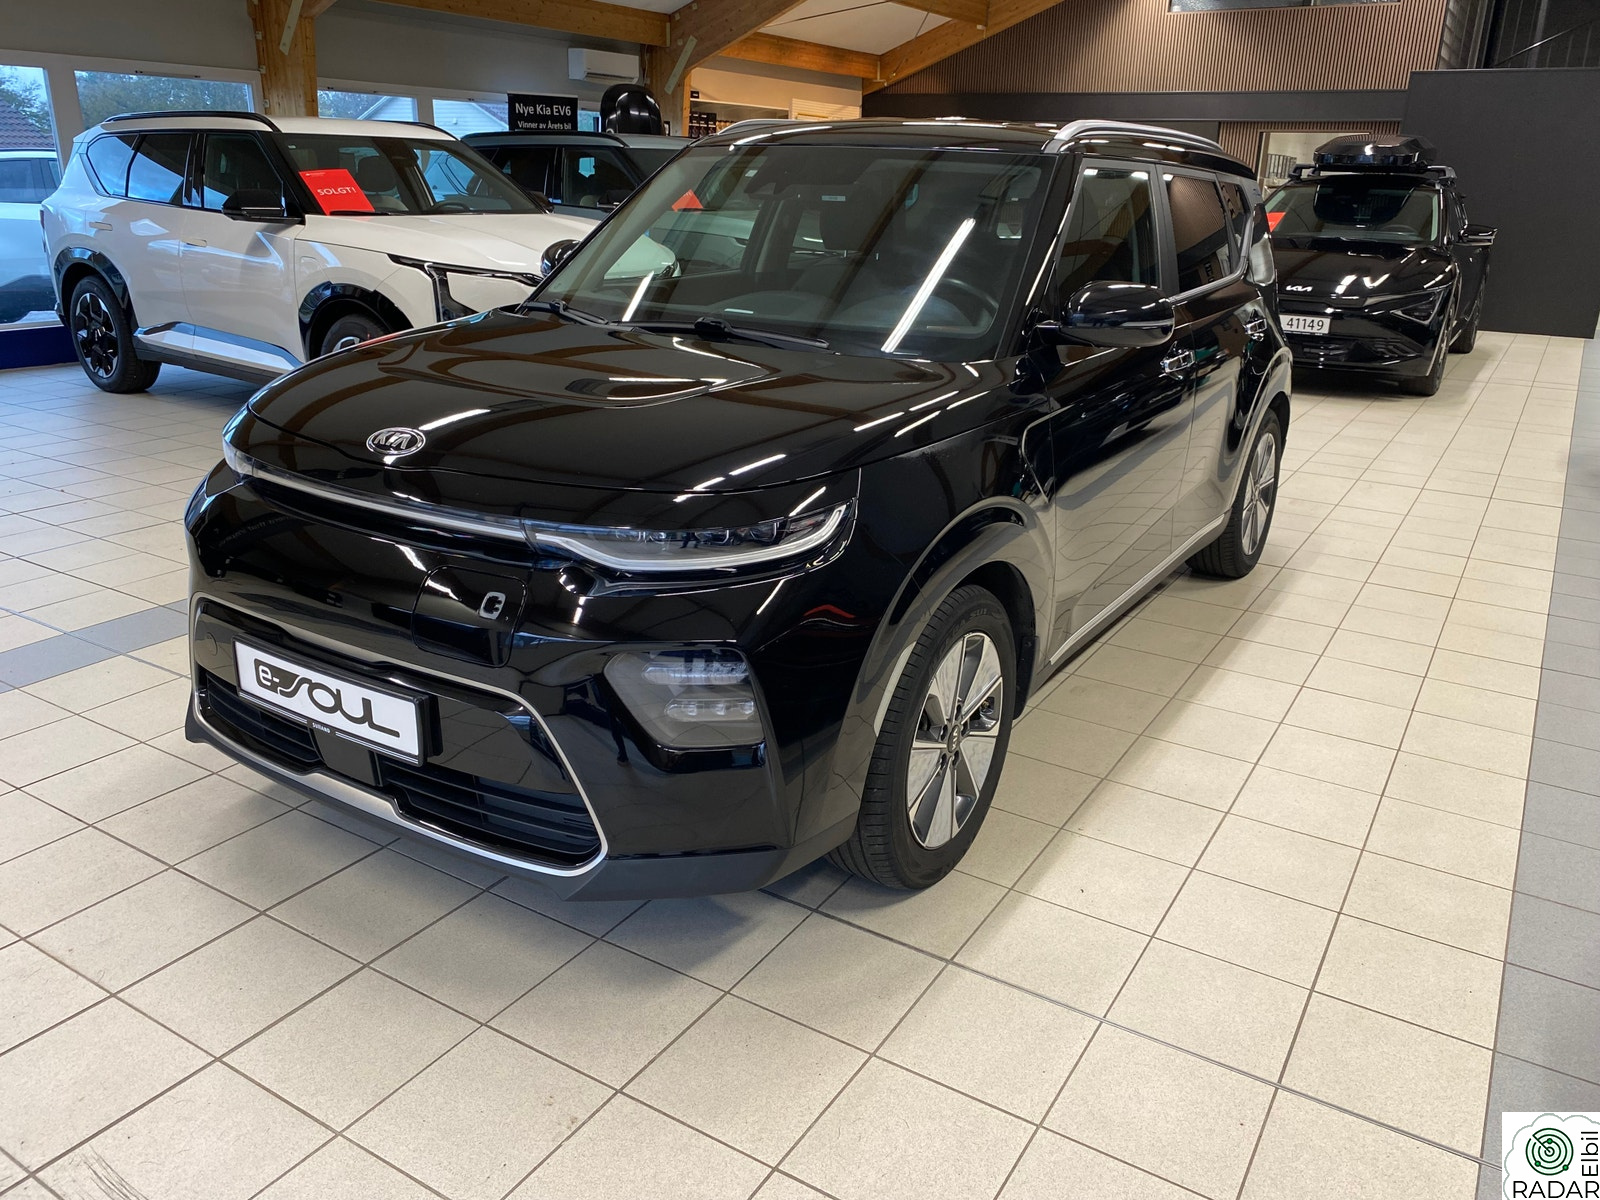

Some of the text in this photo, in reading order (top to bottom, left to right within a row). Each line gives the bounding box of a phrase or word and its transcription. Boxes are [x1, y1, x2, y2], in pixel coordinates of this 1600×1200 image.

[515, 103, 572, 116] Nye Kia EV6
[517, 120, 538, 129] Vinner
[564, 122, 572, 130] bil
[317, 186, 357, 196] SOLGT!
[1286, 317, 1325, 331] 41149
